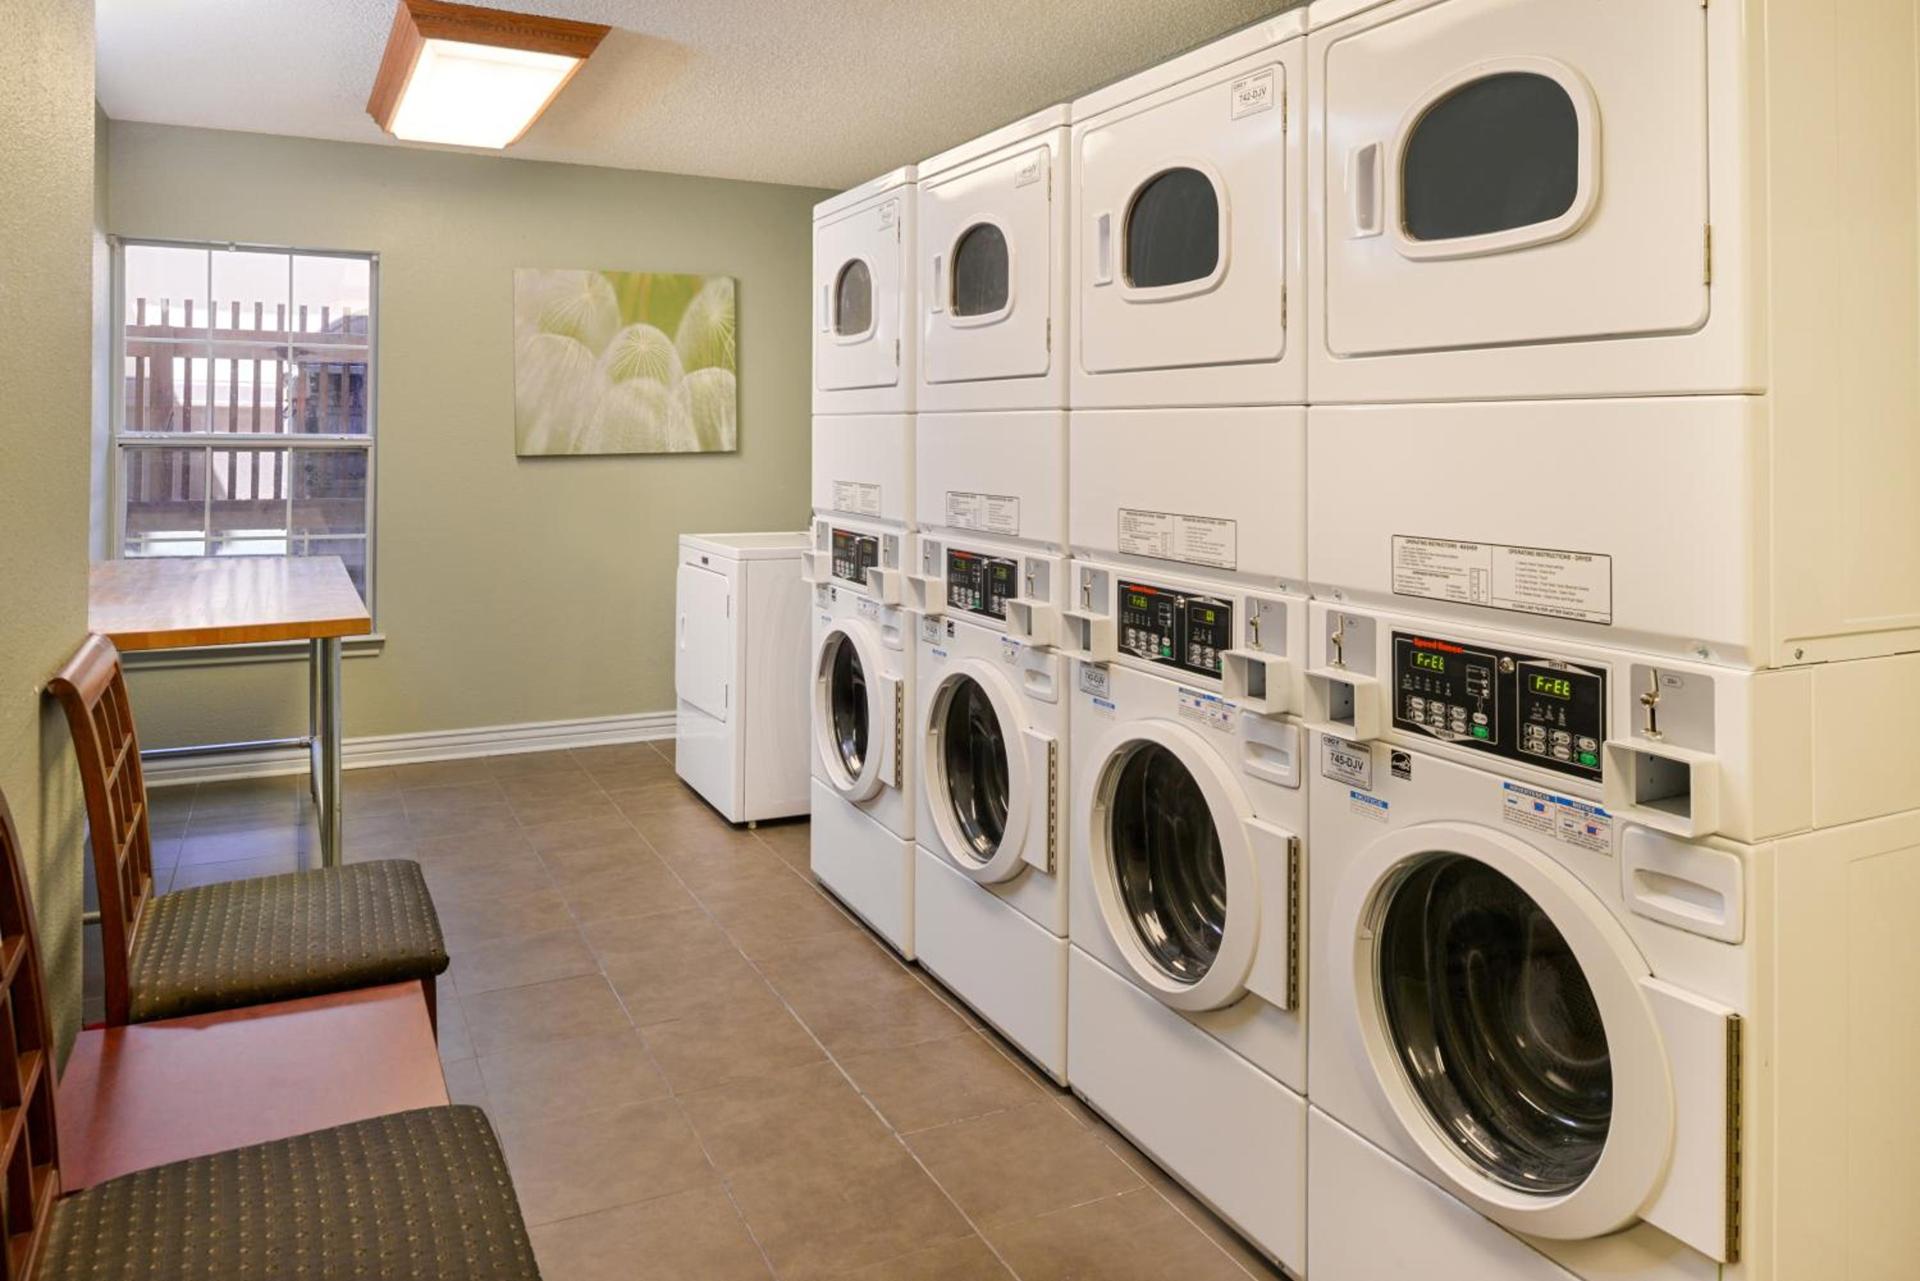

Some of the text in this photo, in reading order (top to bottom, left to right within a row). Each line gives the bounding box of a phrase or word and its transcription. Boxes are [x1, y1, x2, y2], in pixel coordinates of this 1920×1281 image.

[1508, 548, 1535, 557] OPERATING
[1535, 550, 1571, 560] INSTRUCTIONS
[1330, 752, 1364, 771] 745-DJV
